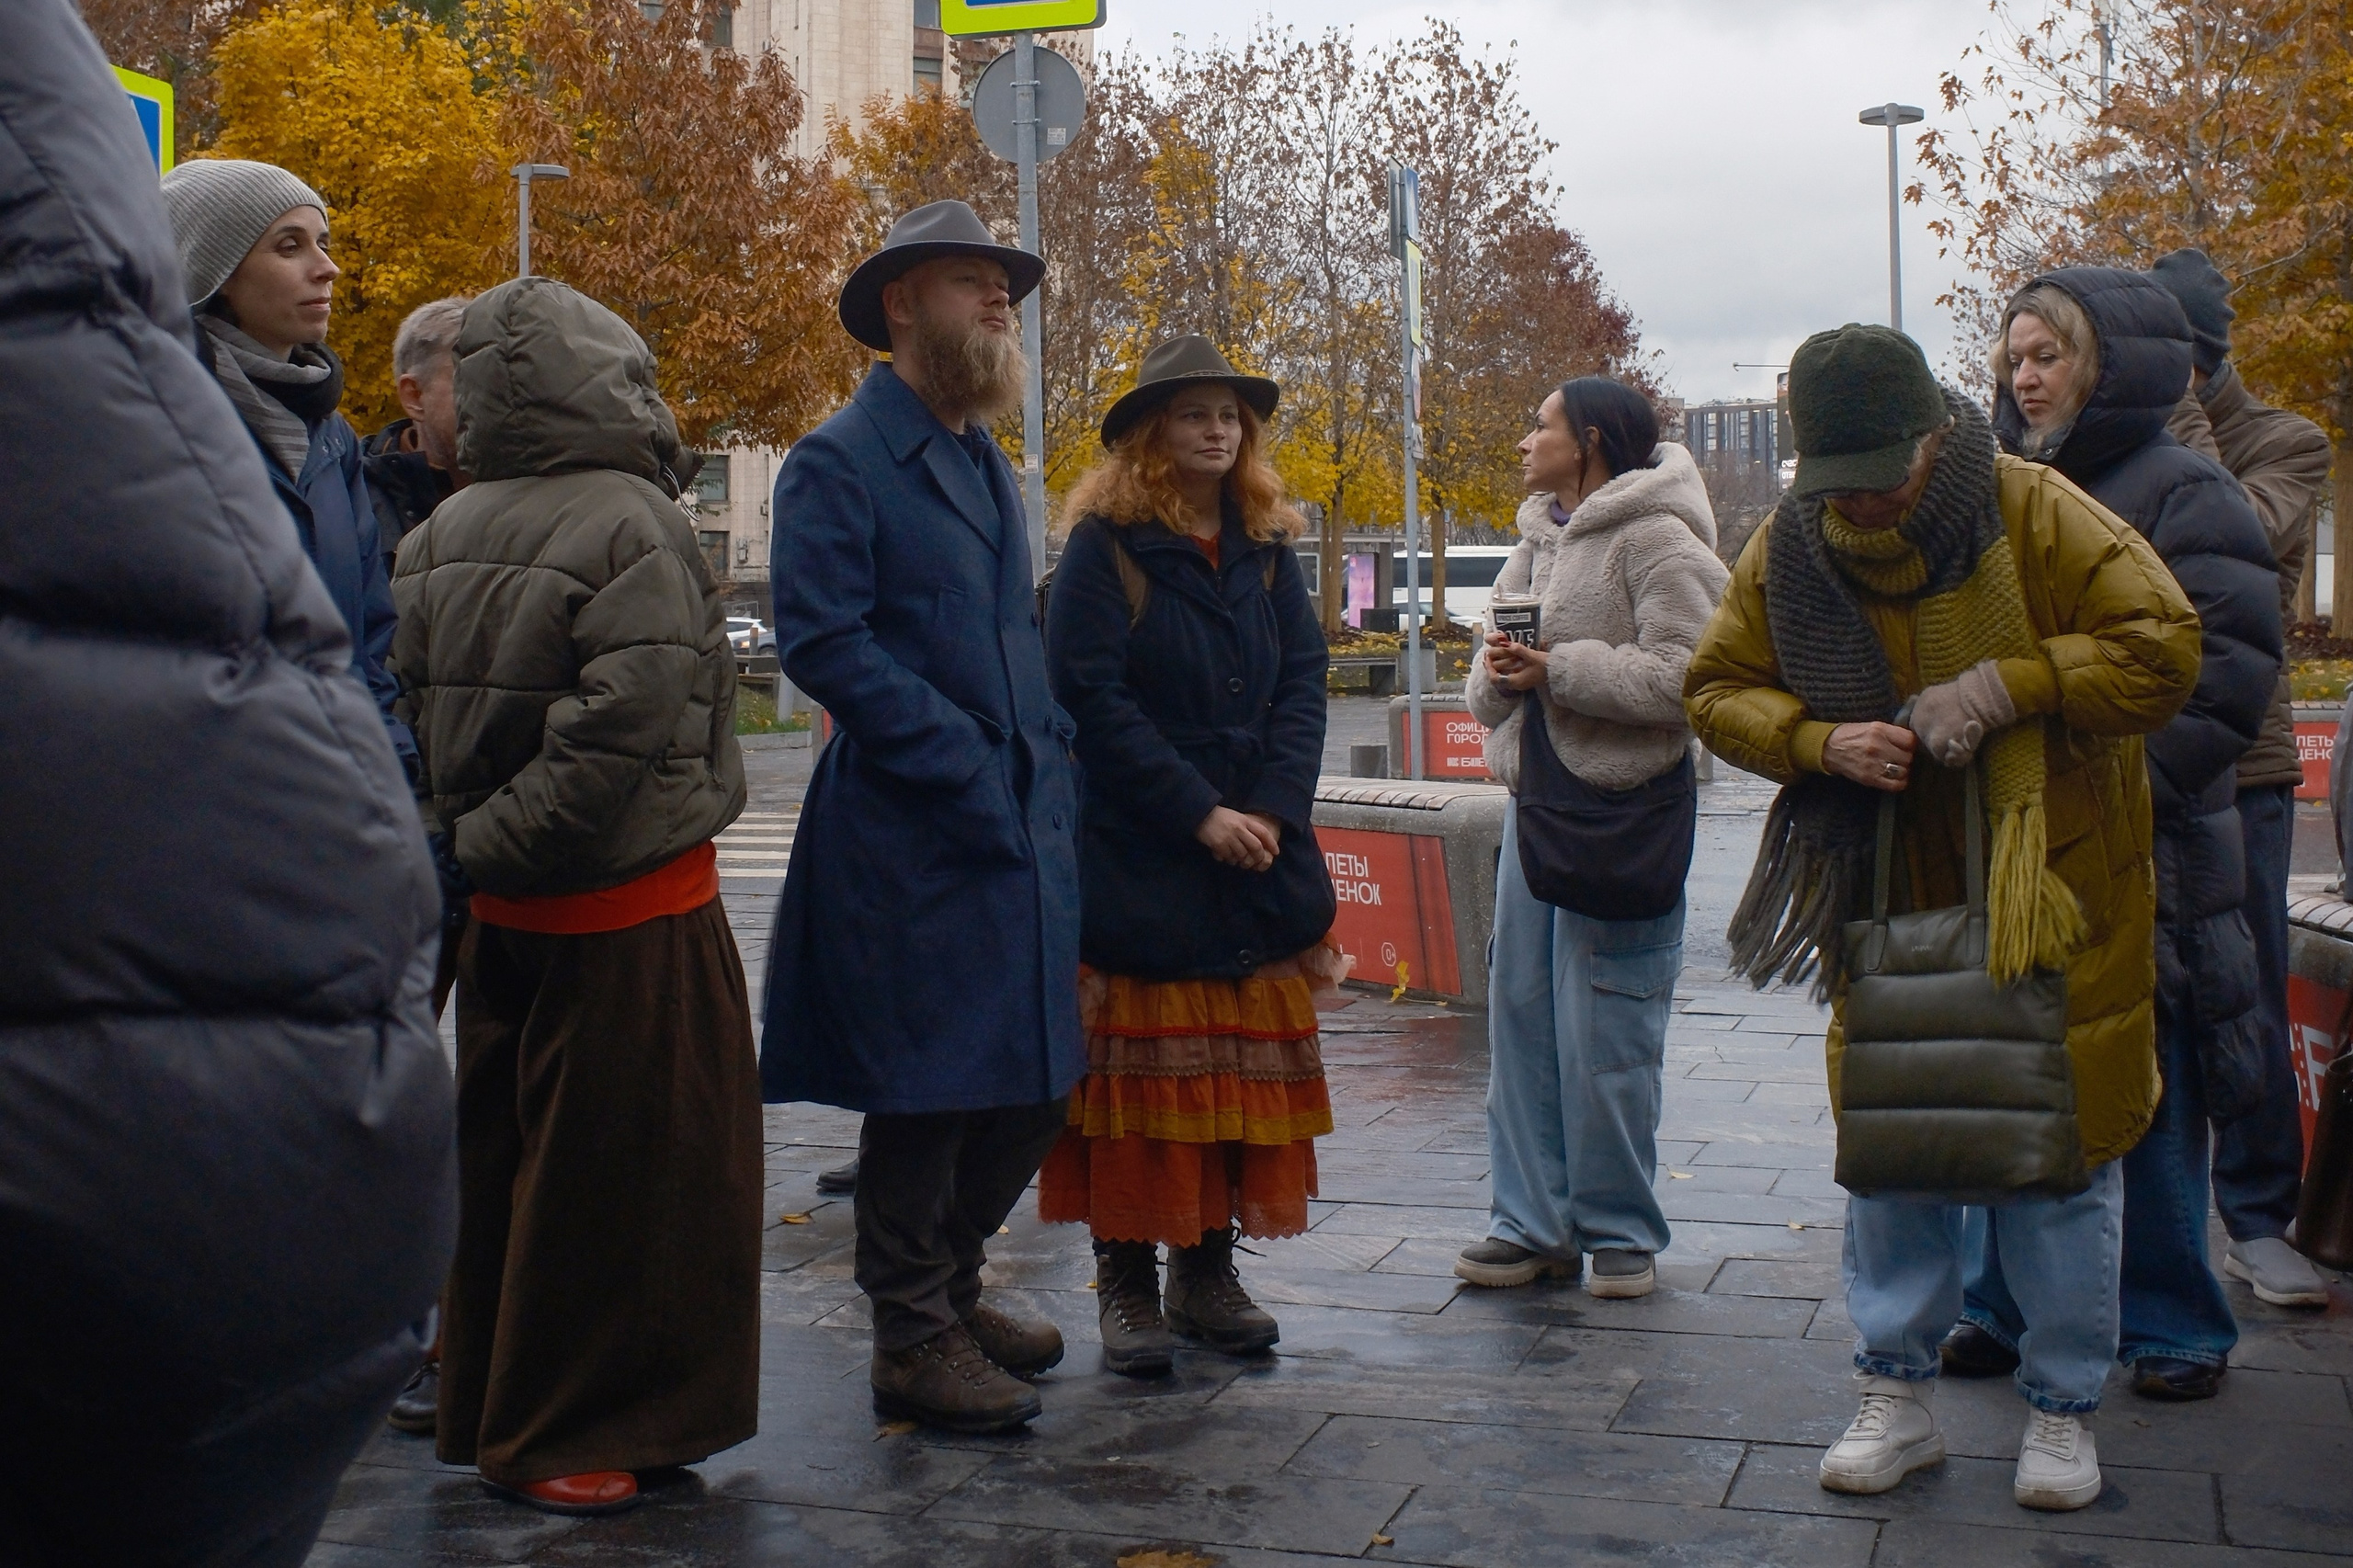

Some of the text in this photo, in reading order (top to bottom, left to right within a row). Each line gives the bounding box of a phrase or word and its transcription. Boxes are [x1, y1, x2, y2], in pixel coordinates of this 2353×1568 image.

[2296, 735, 2336, 747] ЛЕТЫ
[1325, 852, 1369, 878] ЛЕТЫ
[1331, 879, 1381, 905] ЕНОК
